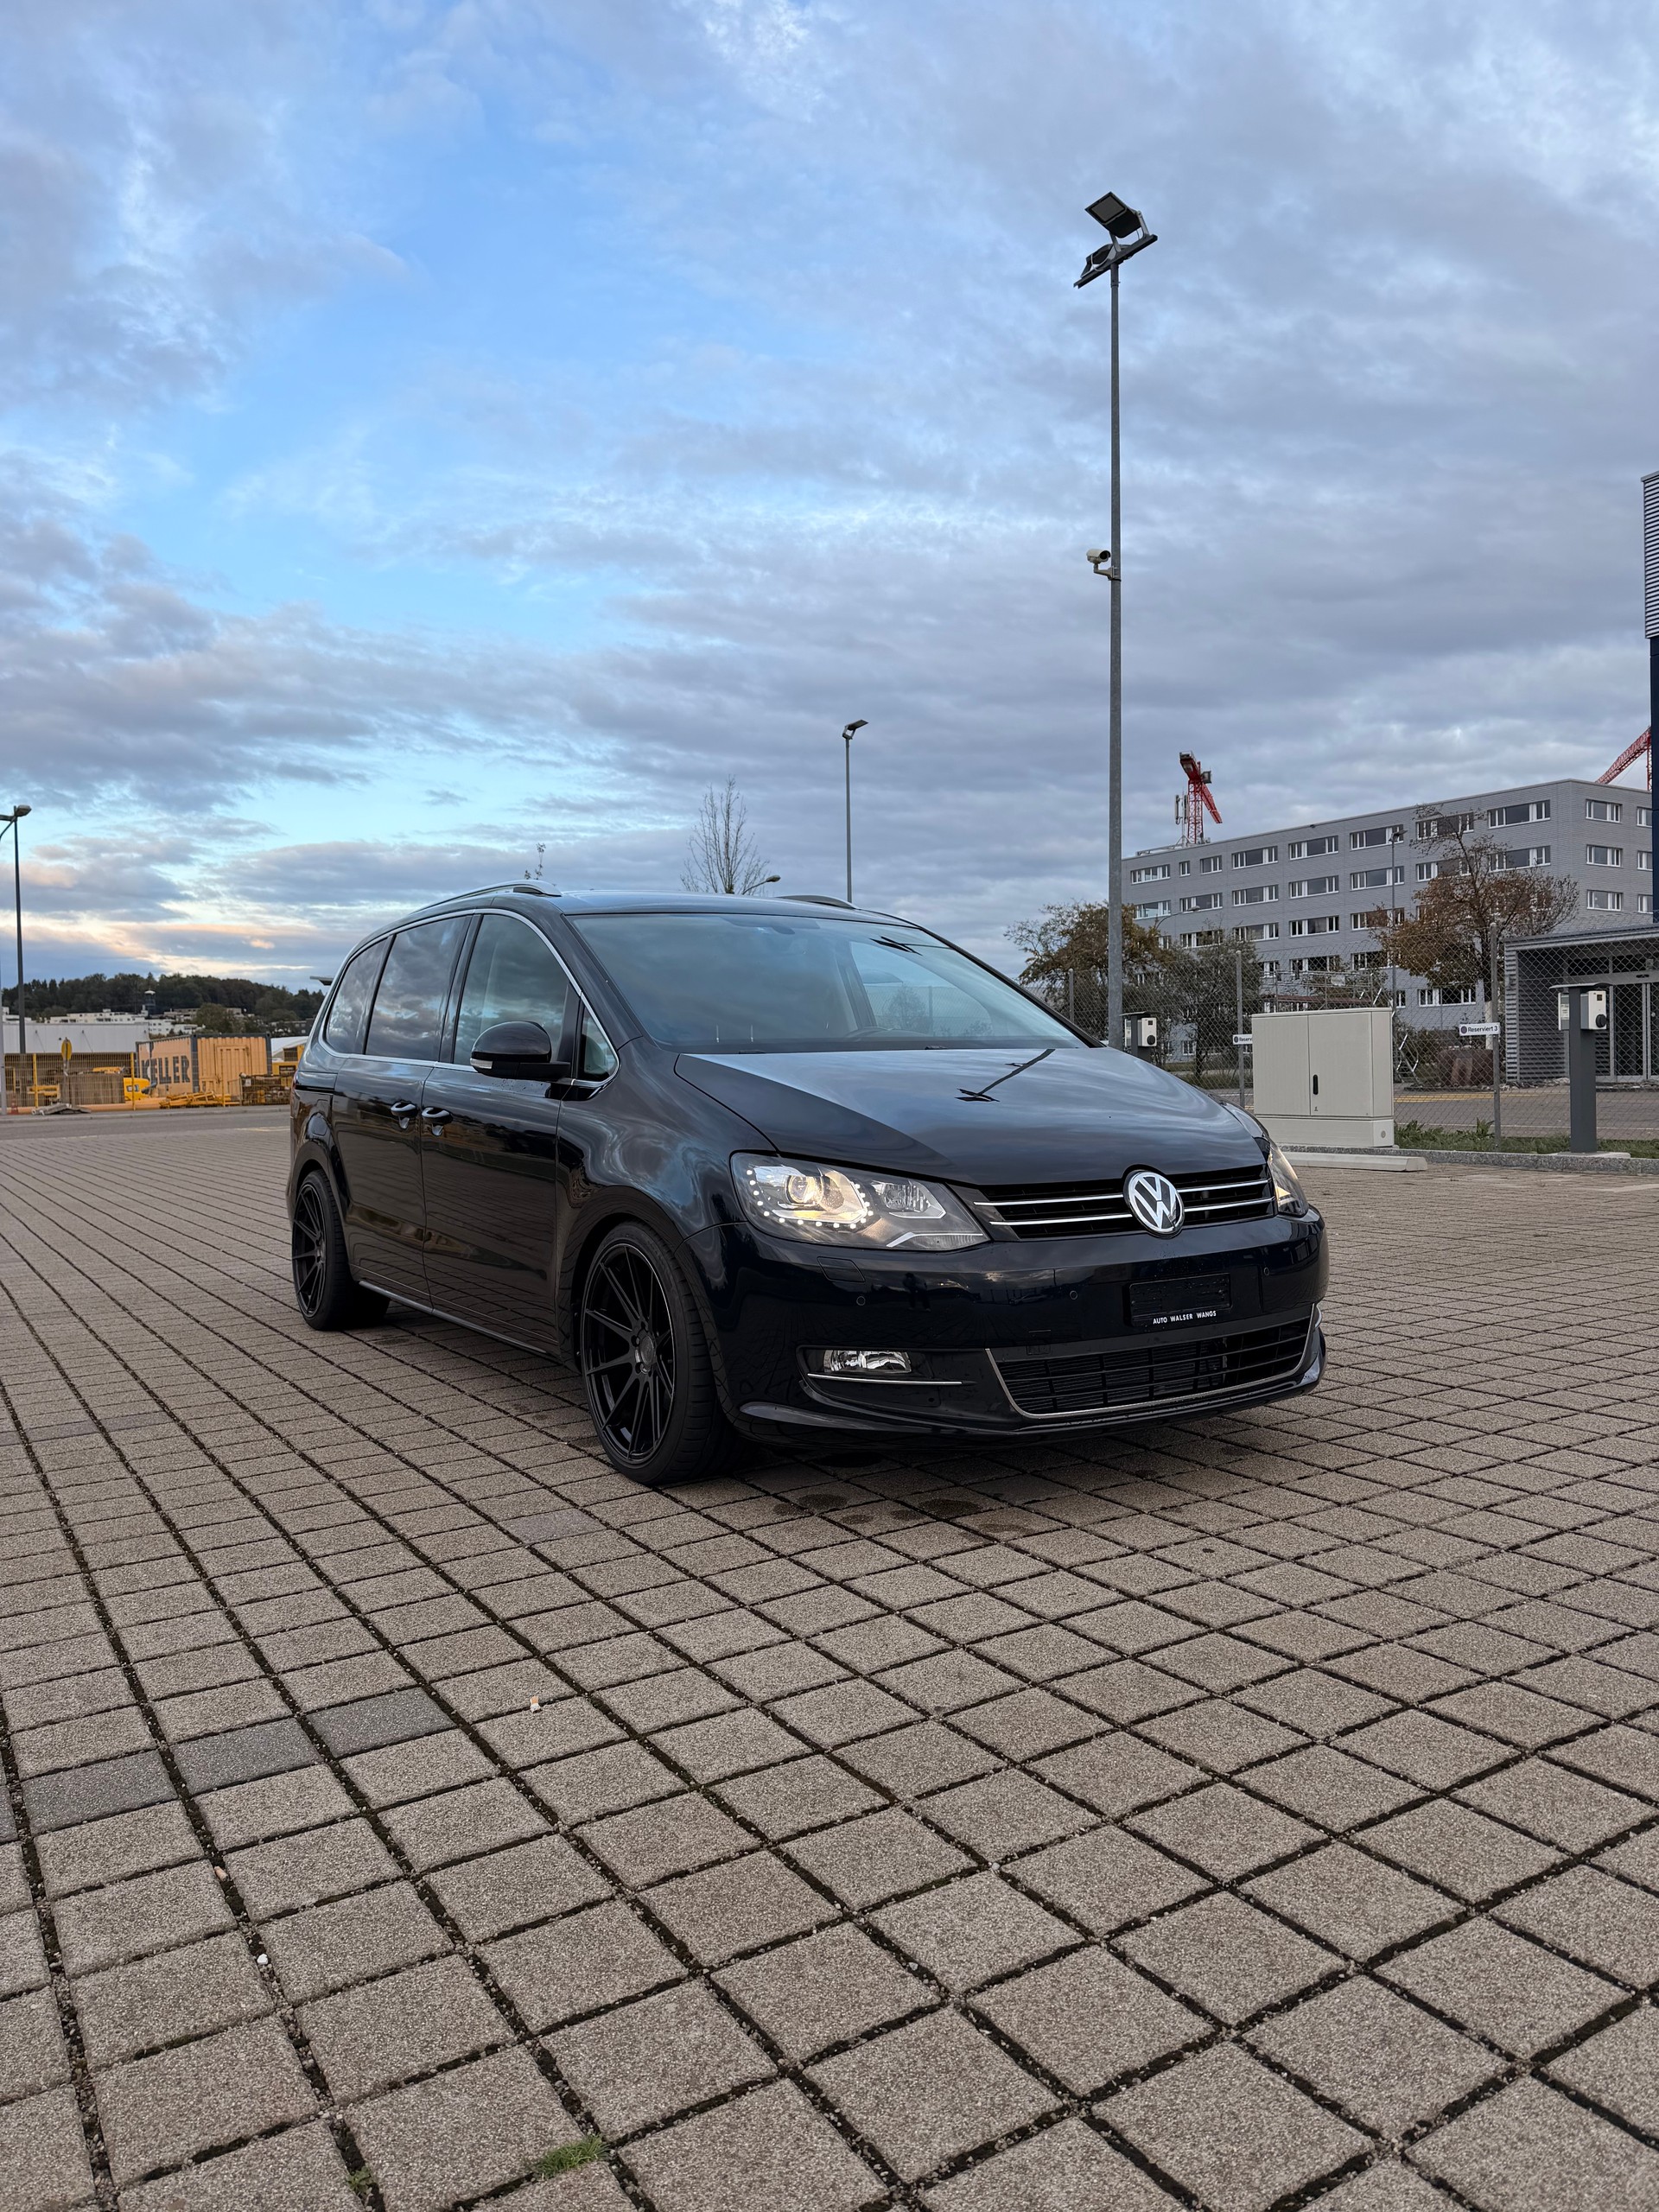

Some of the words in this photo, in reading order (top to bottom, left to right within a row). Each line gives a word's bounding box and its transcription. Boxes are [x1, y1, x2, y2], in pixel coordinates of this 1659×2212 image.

[1128, 1172, 1182, 1232] VW
[1170, 1313, 1193, 1322] WALSER
[1196, 1310, 1217, 1319] WANGS
